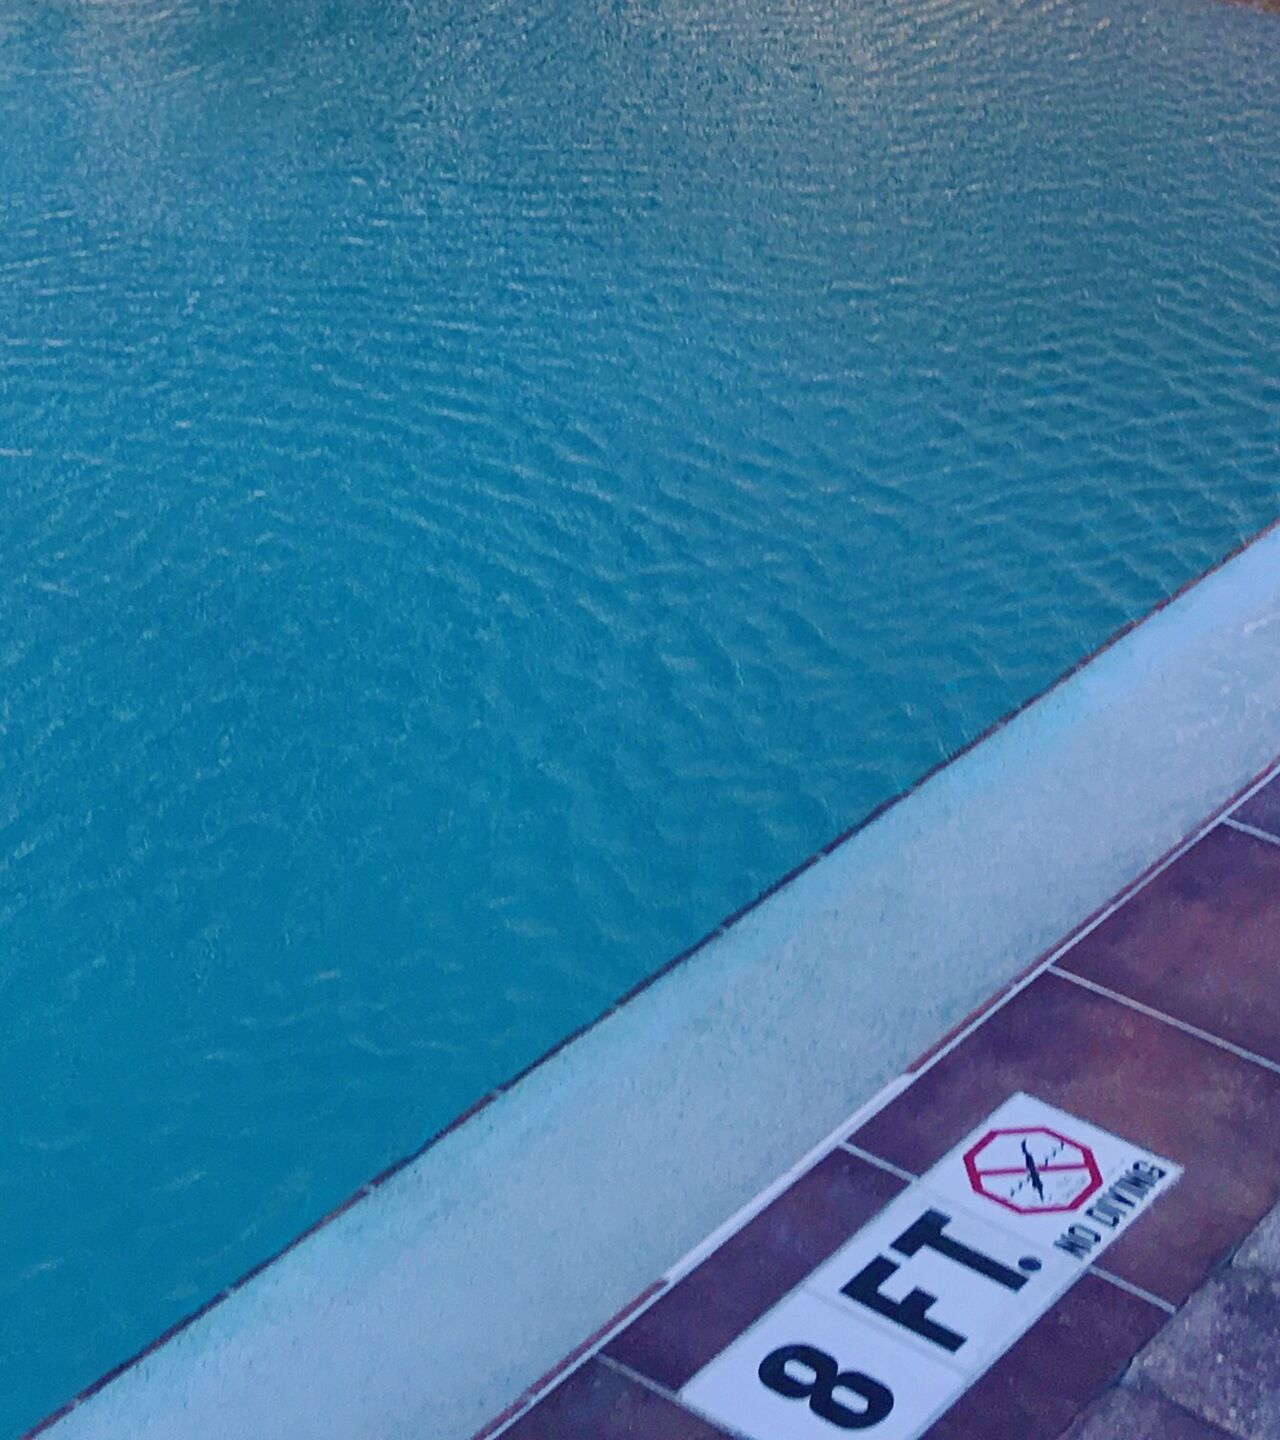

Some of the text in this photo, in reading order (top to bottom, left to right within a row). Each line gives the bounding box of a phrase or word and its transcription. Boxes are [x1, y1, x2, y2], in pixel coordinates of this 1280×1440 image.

[1053, 1161, 1166, 1261] NO DIVING
[758, 1207, 1043, 1429] 8 FT.
